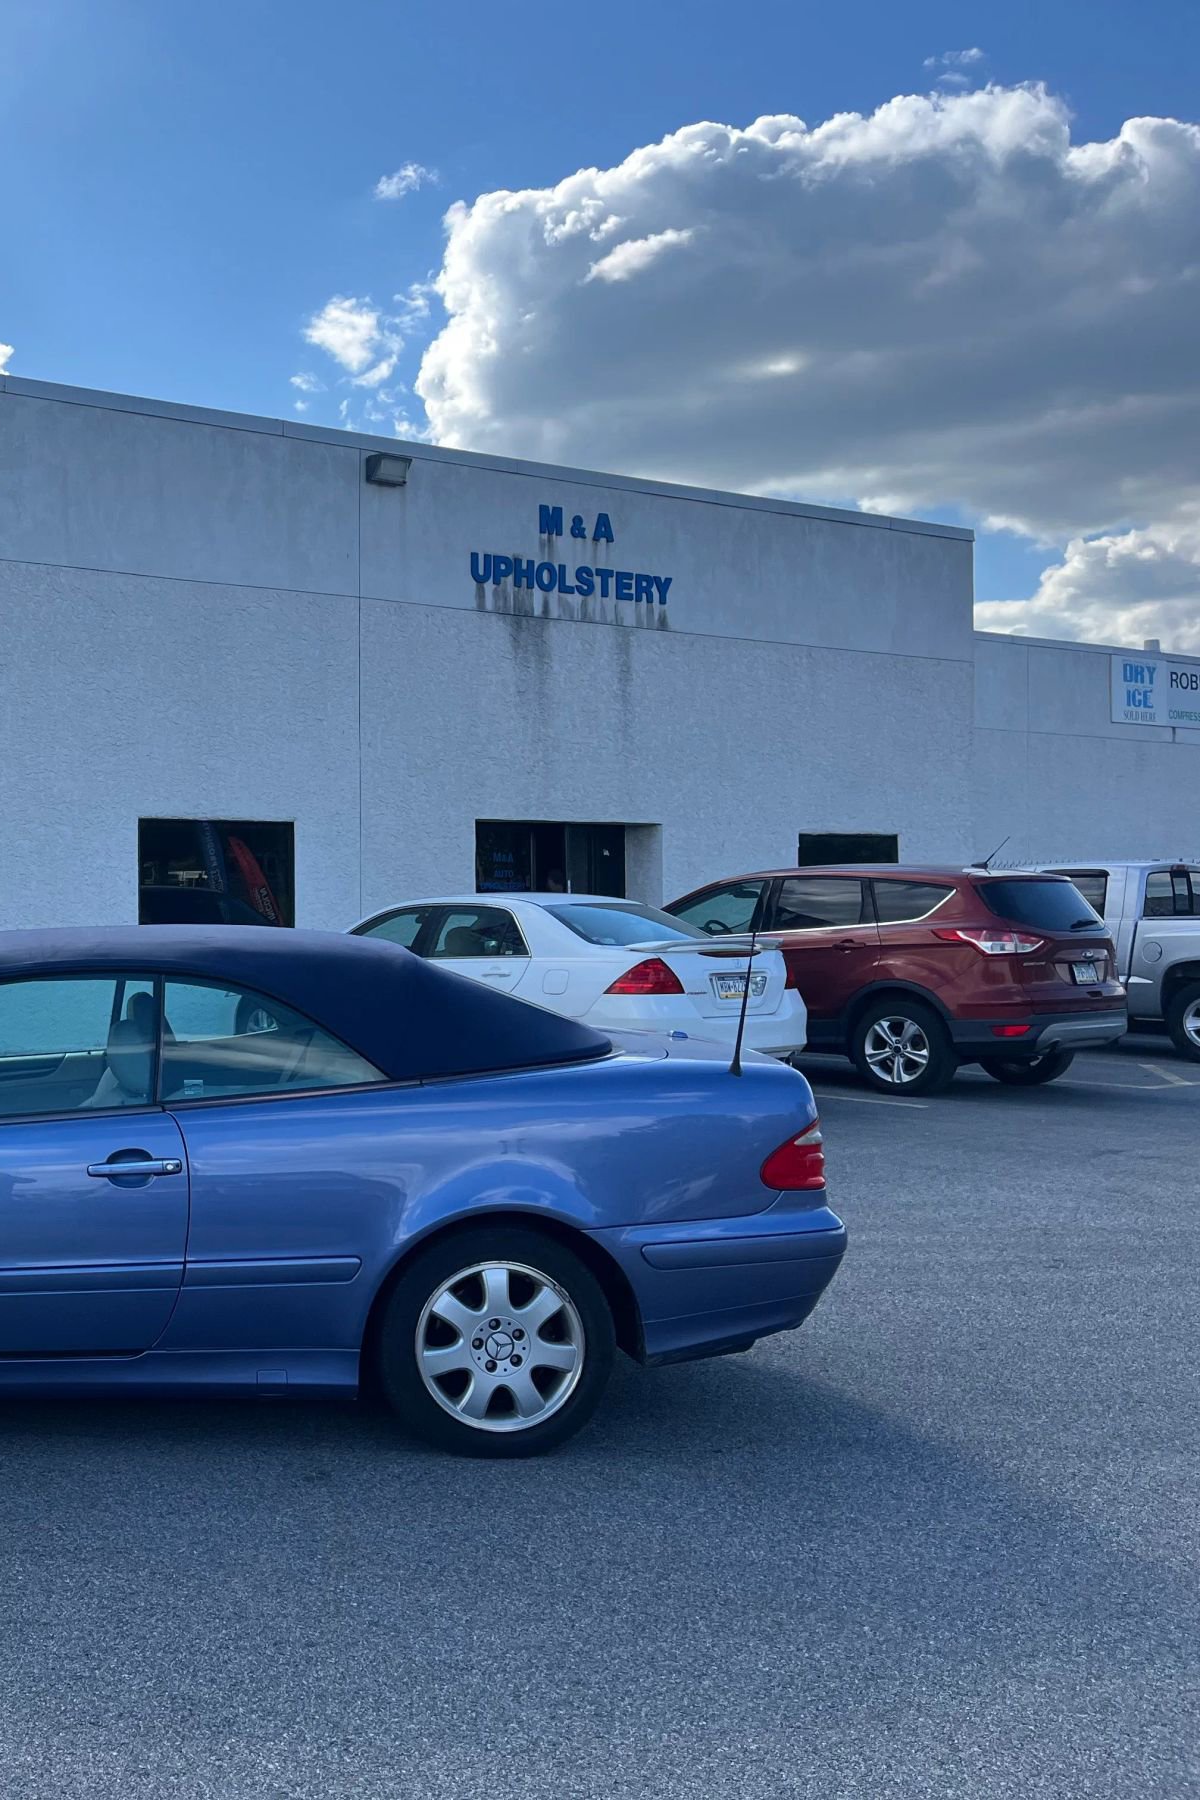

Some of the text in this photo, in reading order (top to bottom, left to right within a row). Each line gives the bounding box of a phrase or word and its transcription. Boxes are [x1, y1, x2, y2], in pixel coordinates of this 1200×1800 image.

[538, 504, 614, 543] M & A
[470, 552, 673, 605] UPHOLSTERY
[1122, 663, 1156, 685] DRY
[1170, 671, 1200, 690] ROB
[1126, 688, 1154, 708] ICE
